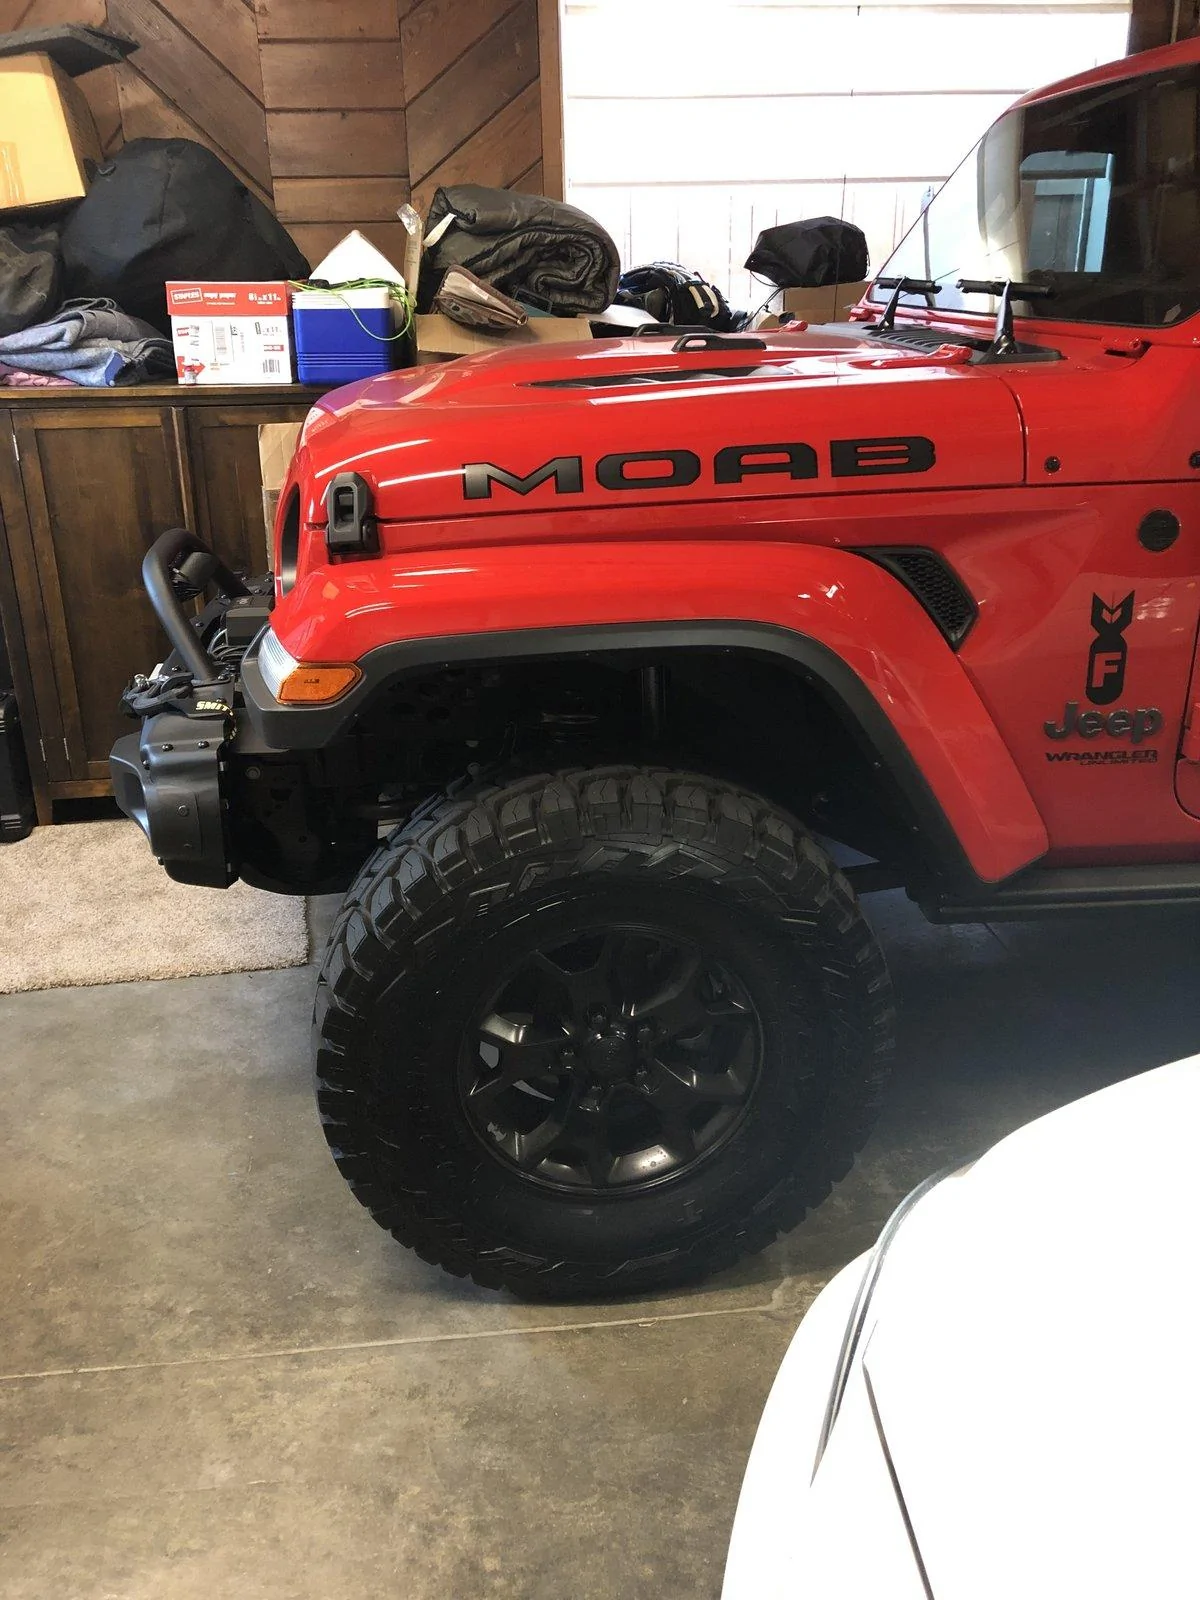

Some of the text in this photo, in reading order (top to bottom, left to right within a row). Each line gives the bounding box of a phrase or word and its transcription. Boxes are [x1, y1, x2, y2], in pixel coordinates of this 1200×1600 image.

[462, 436, 937, 500] MOAB
[1043, 700, 1163, 744] Jeep
[1045, 749, 1158, 762] WRANGLER
